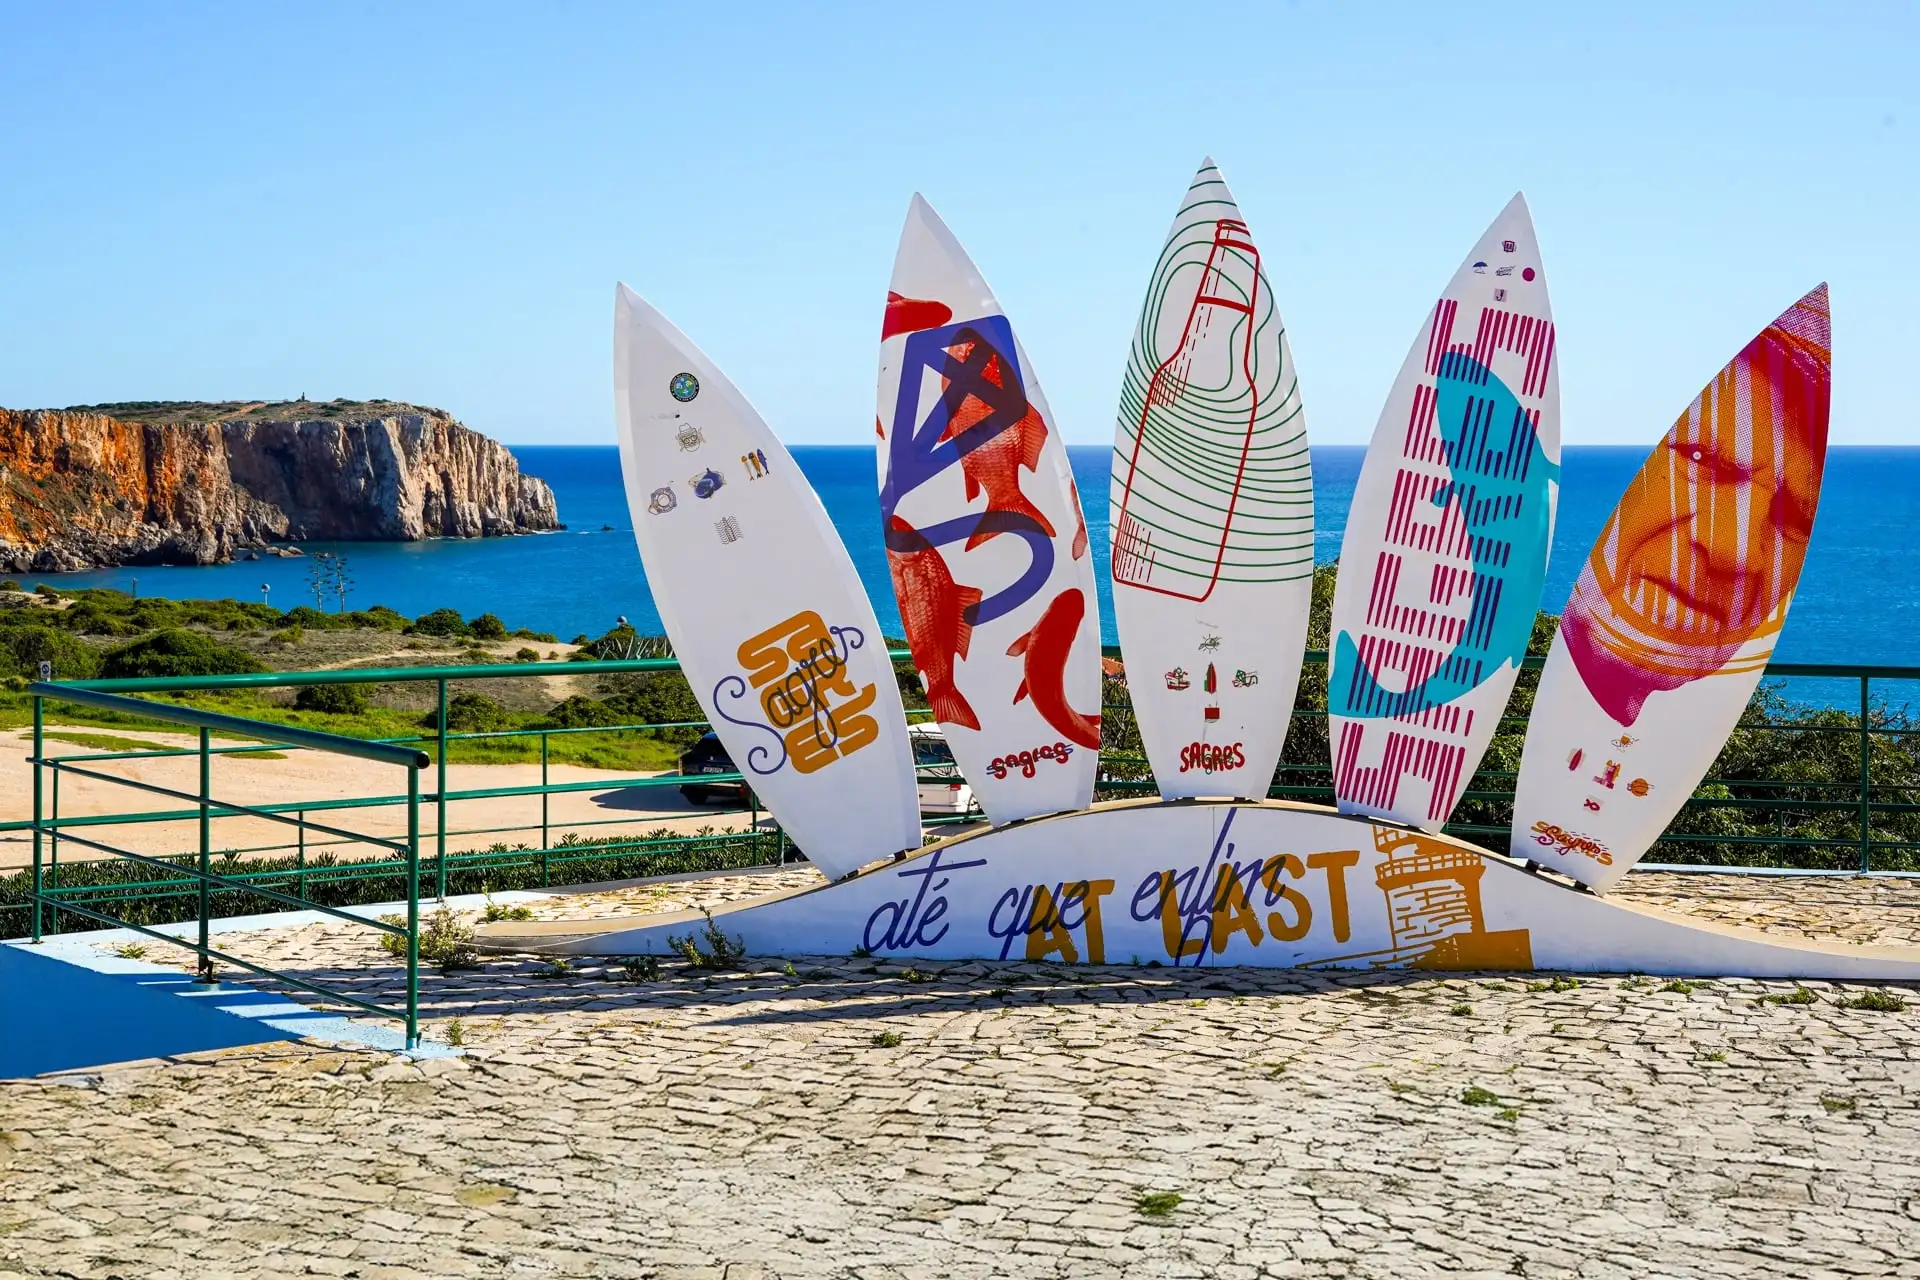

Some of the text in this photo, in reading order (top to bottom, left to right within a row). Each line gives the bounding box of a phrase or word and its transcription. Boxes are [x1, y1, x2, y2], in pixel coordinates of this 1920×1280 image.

[713, 626, 864, 774] Sagres
[863, 807, 1286, 967] até que enfim
[1026, 850, 1361, 965] AT LAST
